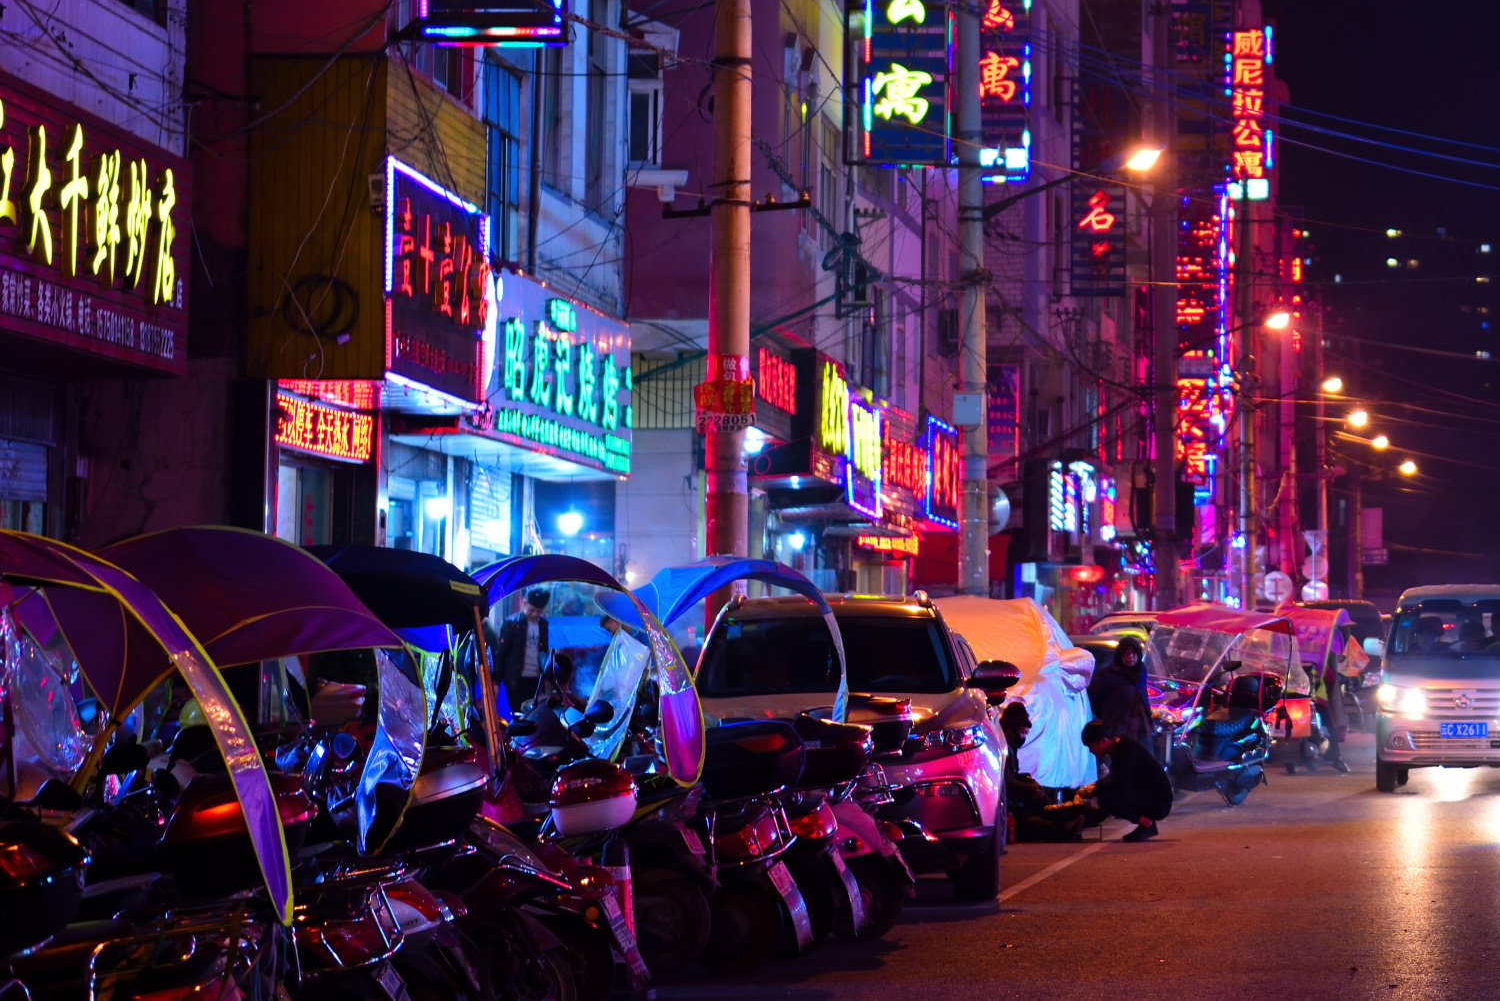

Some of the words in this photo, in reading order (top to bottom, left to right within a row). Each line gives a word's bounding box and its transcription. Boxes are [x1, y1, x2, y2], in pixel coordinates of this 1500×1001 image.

[1232, 29, 1265, 179] 威尼拉公寓
